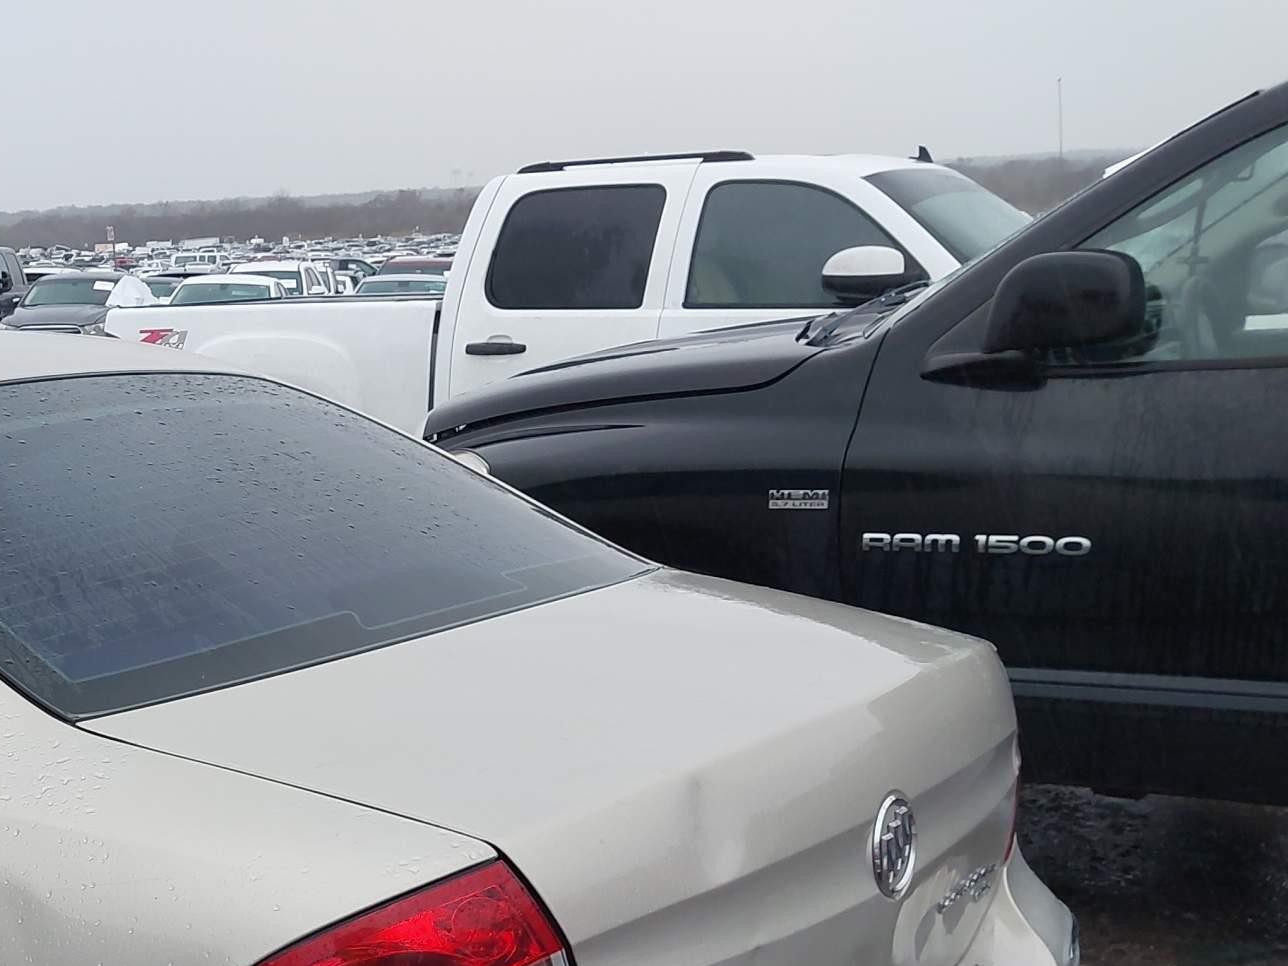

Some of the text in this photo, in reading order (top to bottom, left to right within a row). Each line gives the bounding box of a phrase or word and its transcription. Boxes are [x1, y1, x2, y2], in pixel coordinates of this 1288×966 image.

[768, 489, 829, 500] HEMI
[862, 532, 1092, 555] RAM 1500
